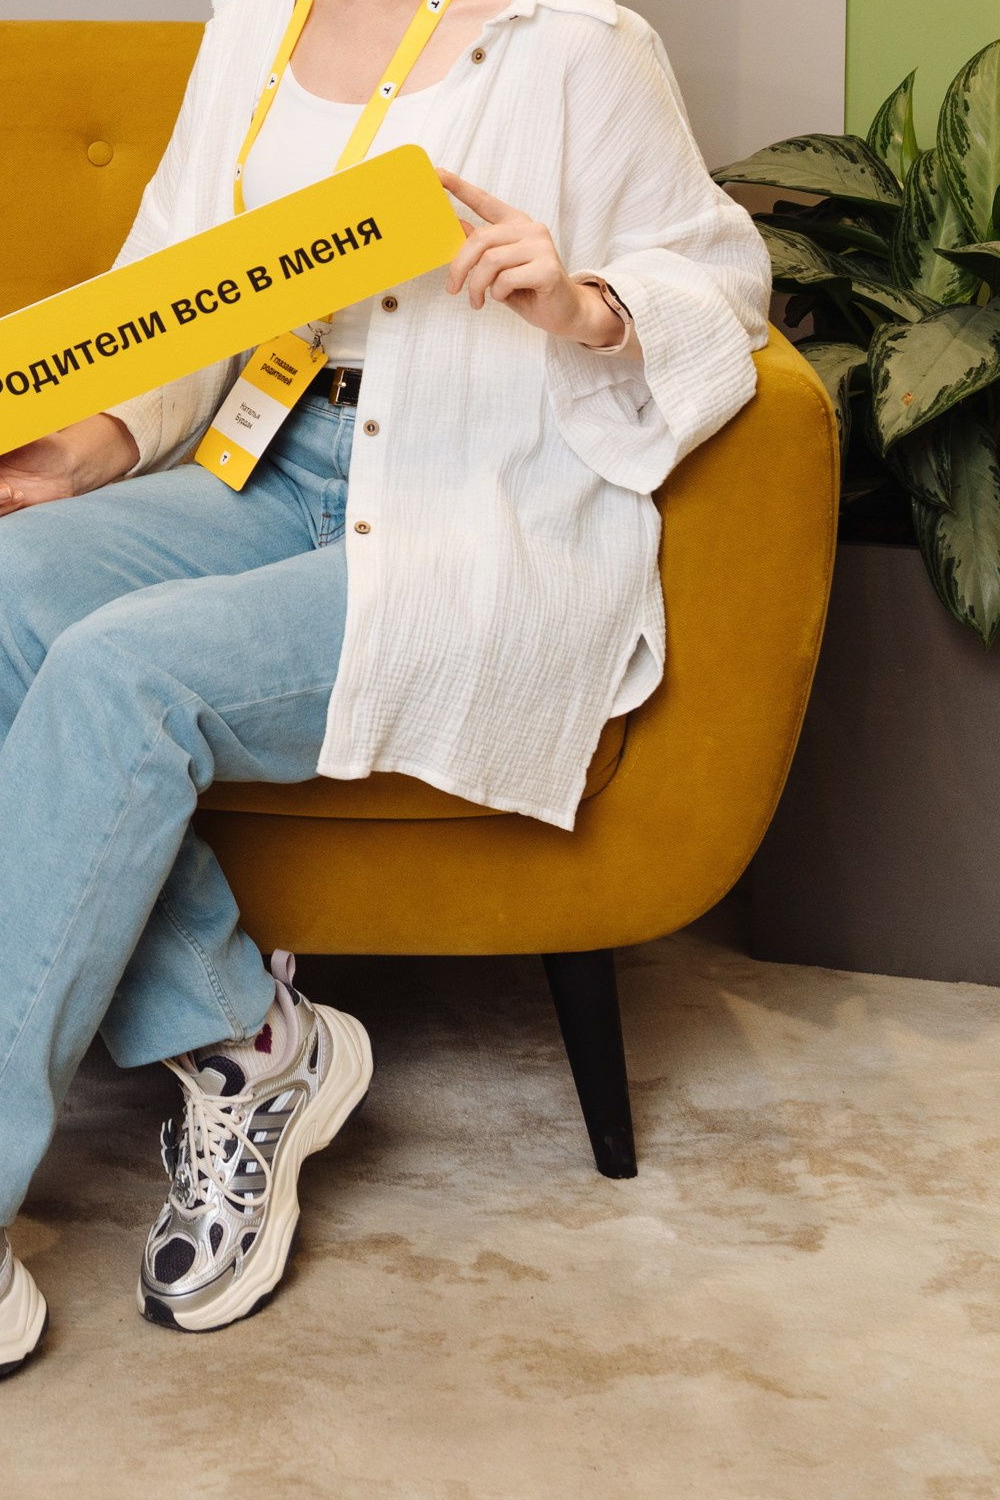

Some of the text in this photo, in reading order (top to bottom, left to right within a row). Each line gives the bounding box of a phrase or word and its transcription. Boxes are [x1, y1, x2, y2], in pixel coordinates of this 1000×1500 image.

[171, 279, 241, 325] все
[247, 266, 273, 293] в
[279, 217, 383, 279] меня
[260, 363, 292, 386] родителей
[273, 356, 297, 376] глазами
[239, 401, 261, 420] Наталья
